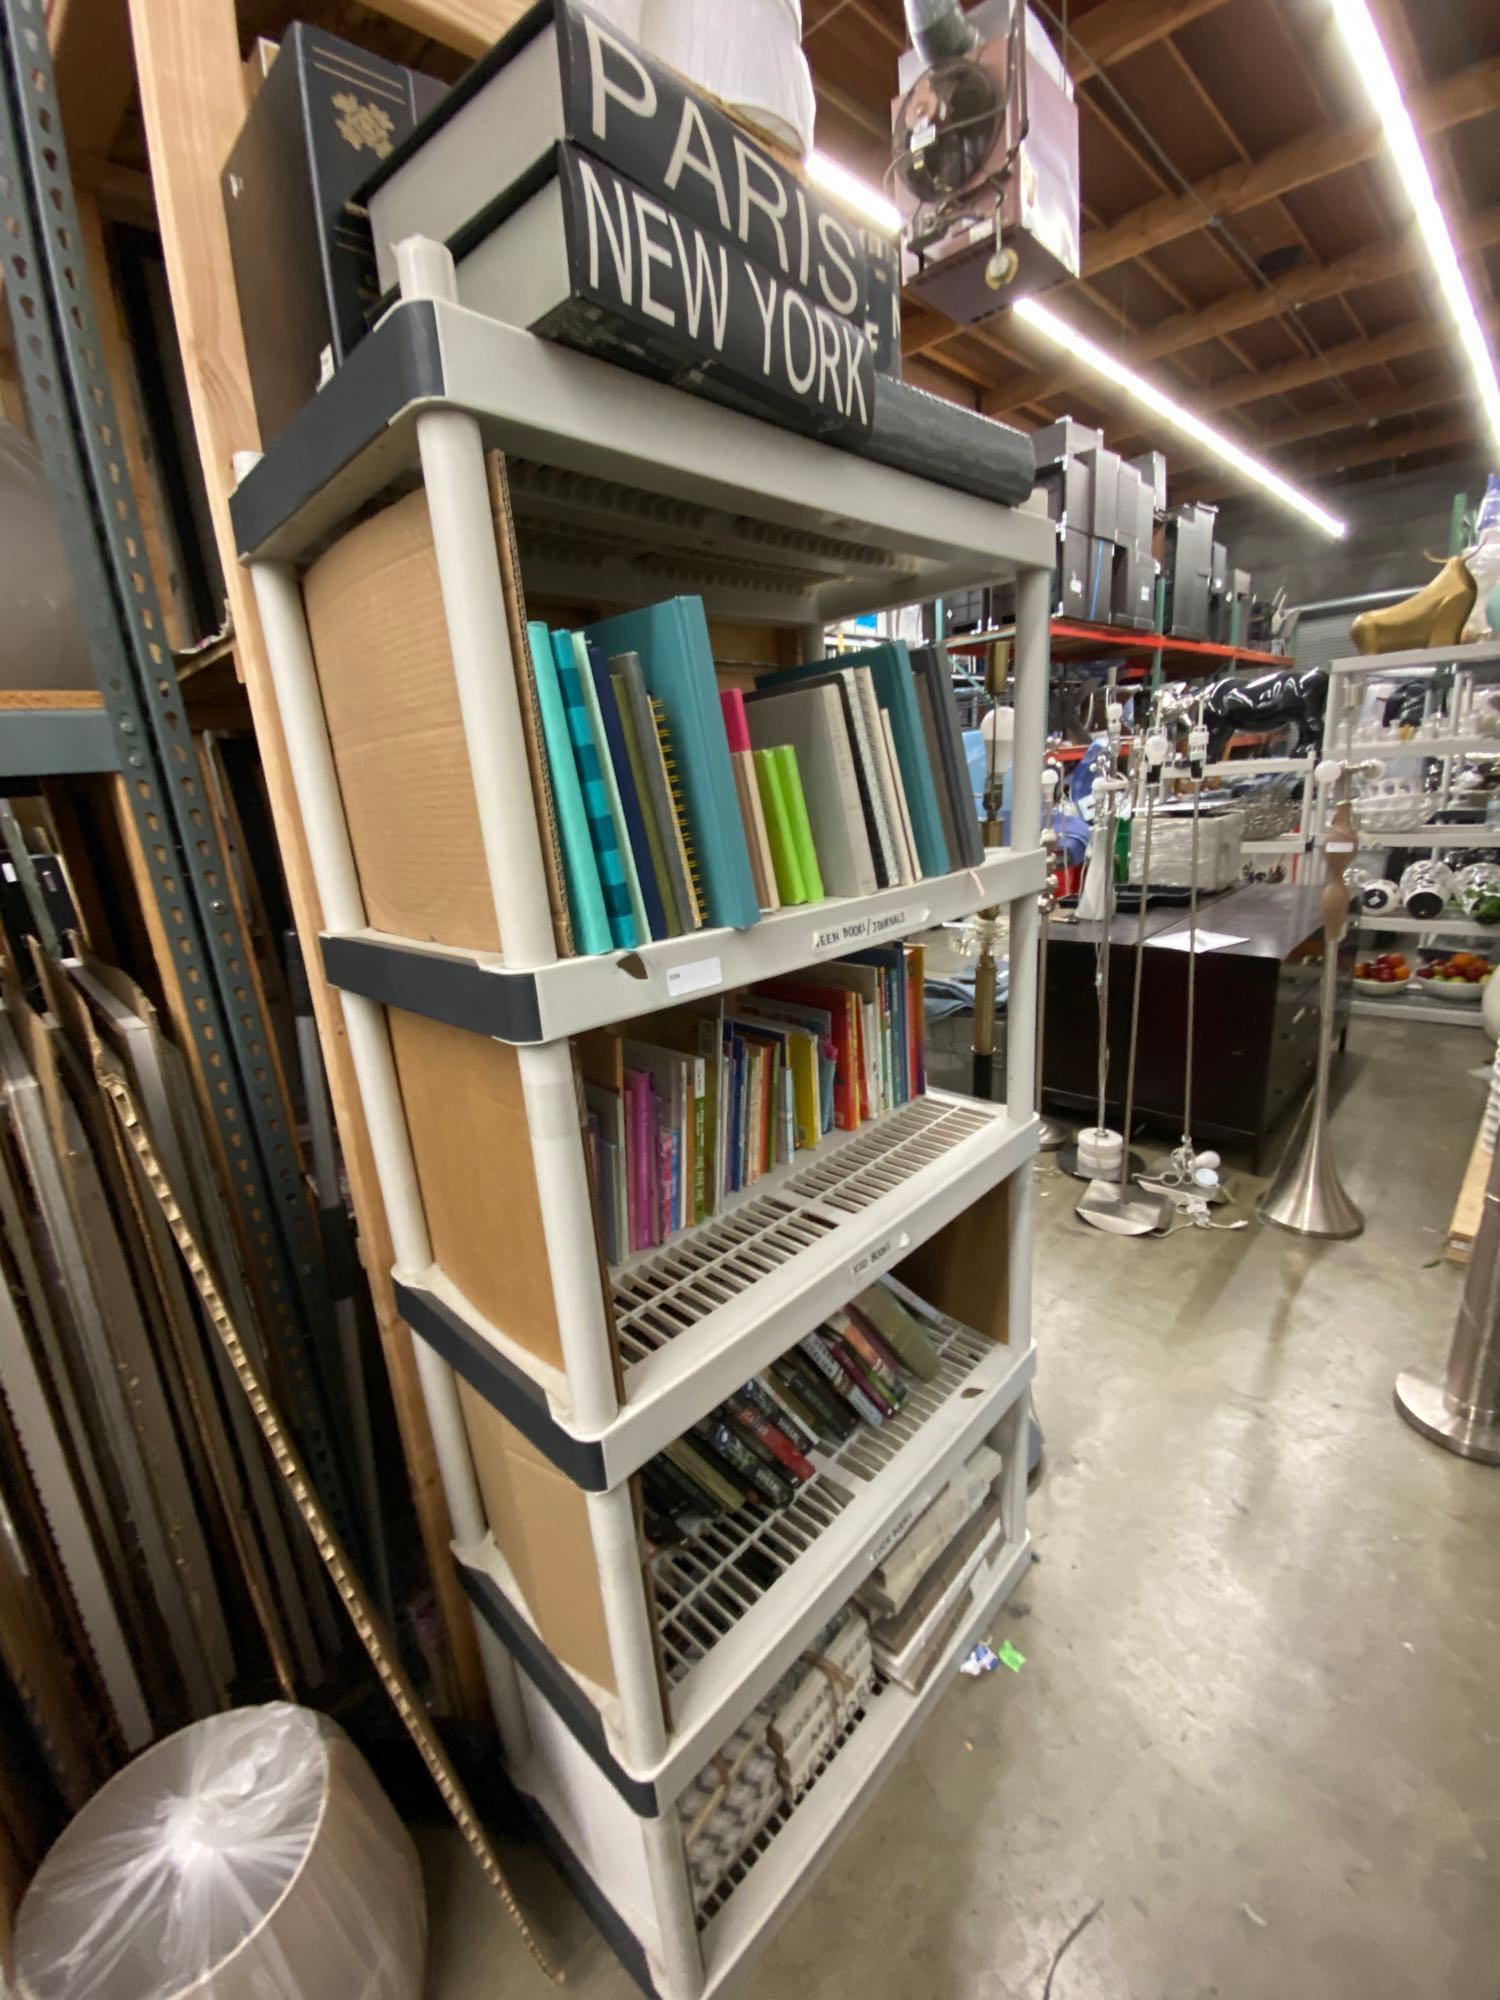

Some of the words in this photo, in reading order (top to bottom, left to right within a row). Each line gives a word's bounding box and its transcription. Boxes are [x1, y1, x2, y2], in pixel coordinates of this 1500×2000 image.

[578, 158, 728, 352] NEW
[744, 261, 868, 425] YORK
[583, 15, 858, 316] PARIS
